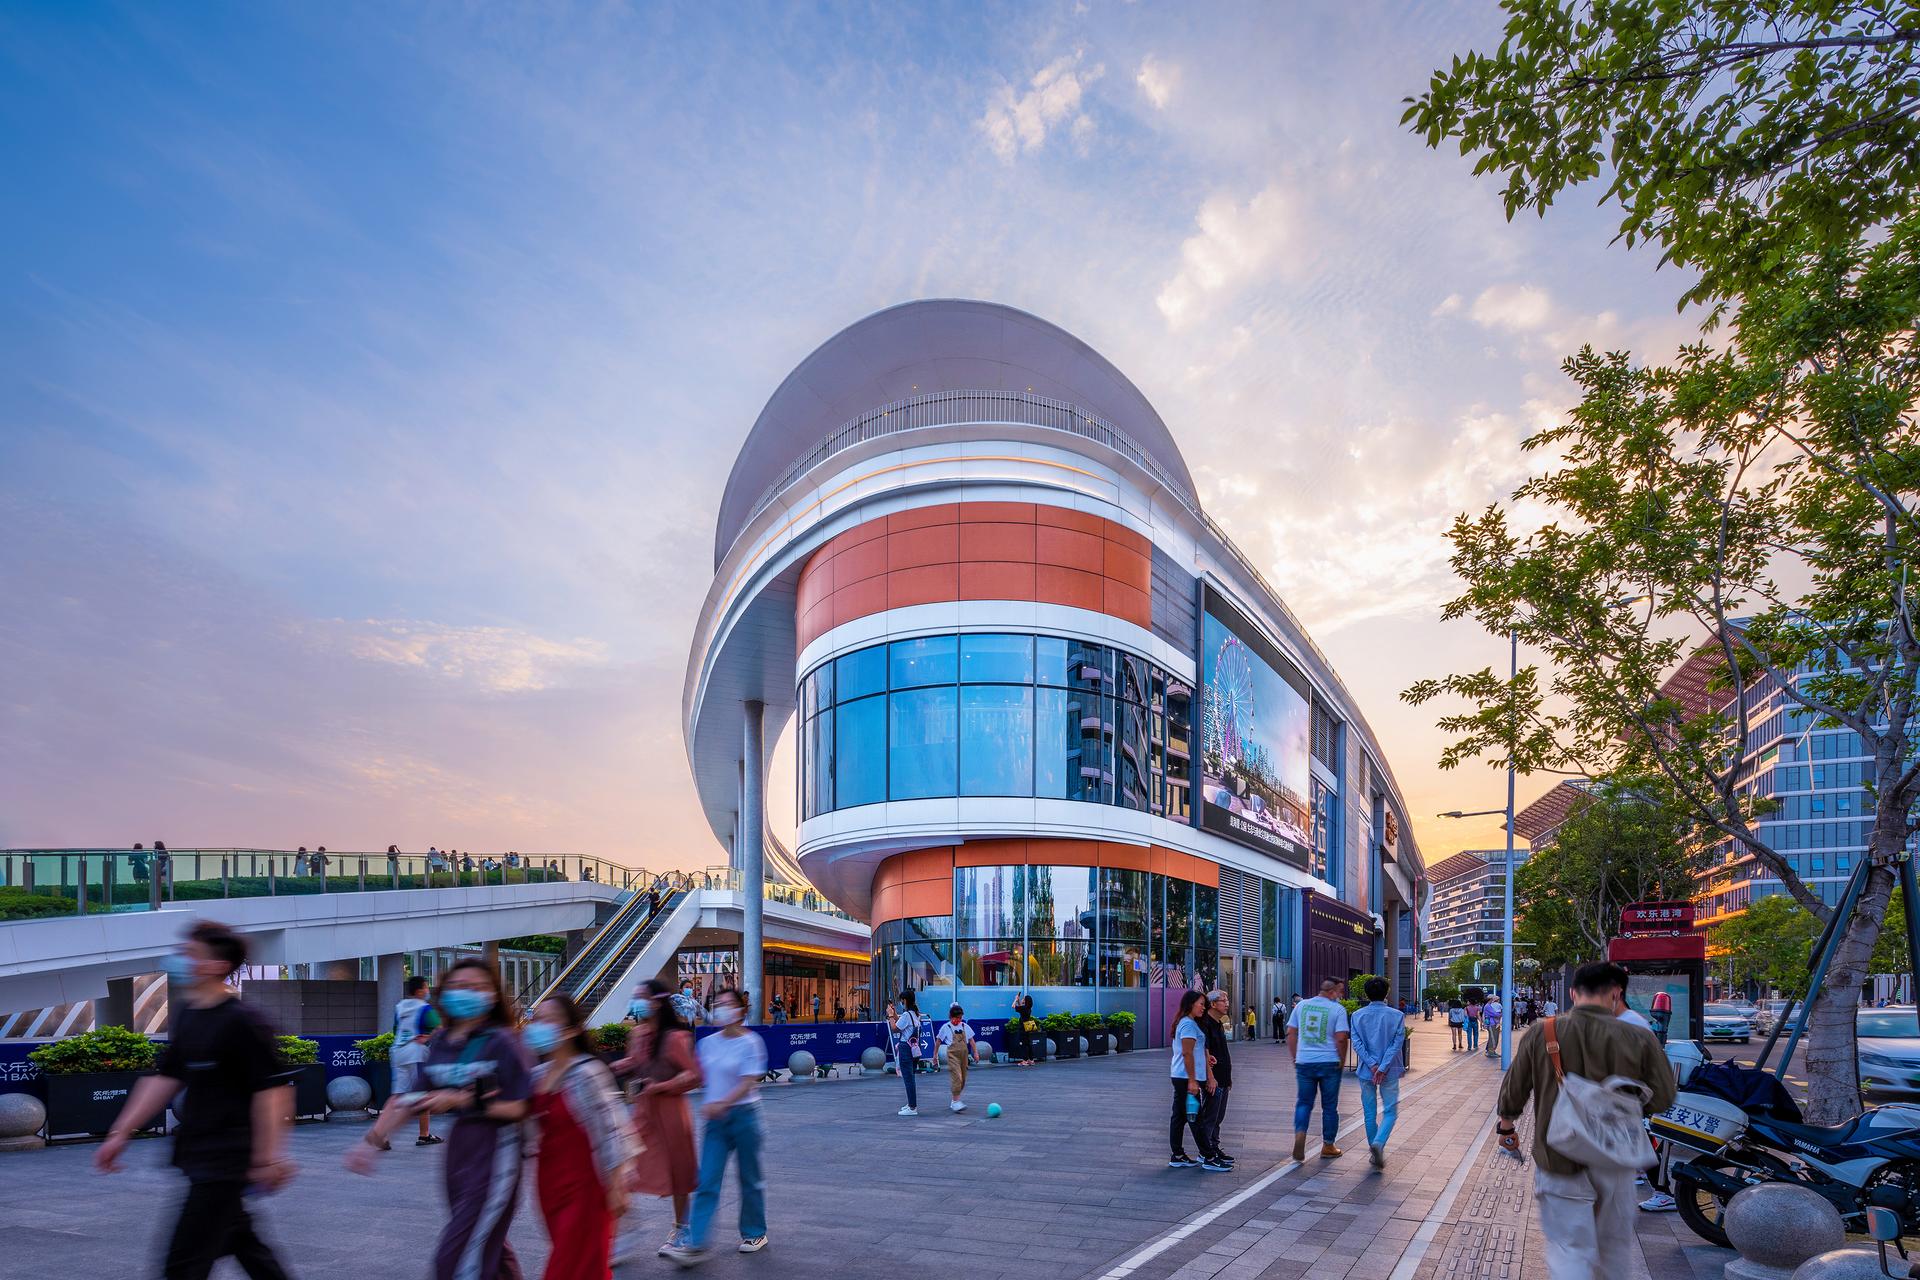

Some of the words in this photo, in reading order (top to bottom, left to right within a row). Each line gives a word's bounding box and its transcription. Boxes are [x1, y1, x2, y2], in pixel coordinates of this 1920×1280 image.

[1636, 909, 1682, 918] 欢乐港湾
[11, 1073, 38, 1081] BAY
[1661, 1107, 1720, 1134] 宝安义警
[1793, 1138, 1820, 1154] YAMAHA
